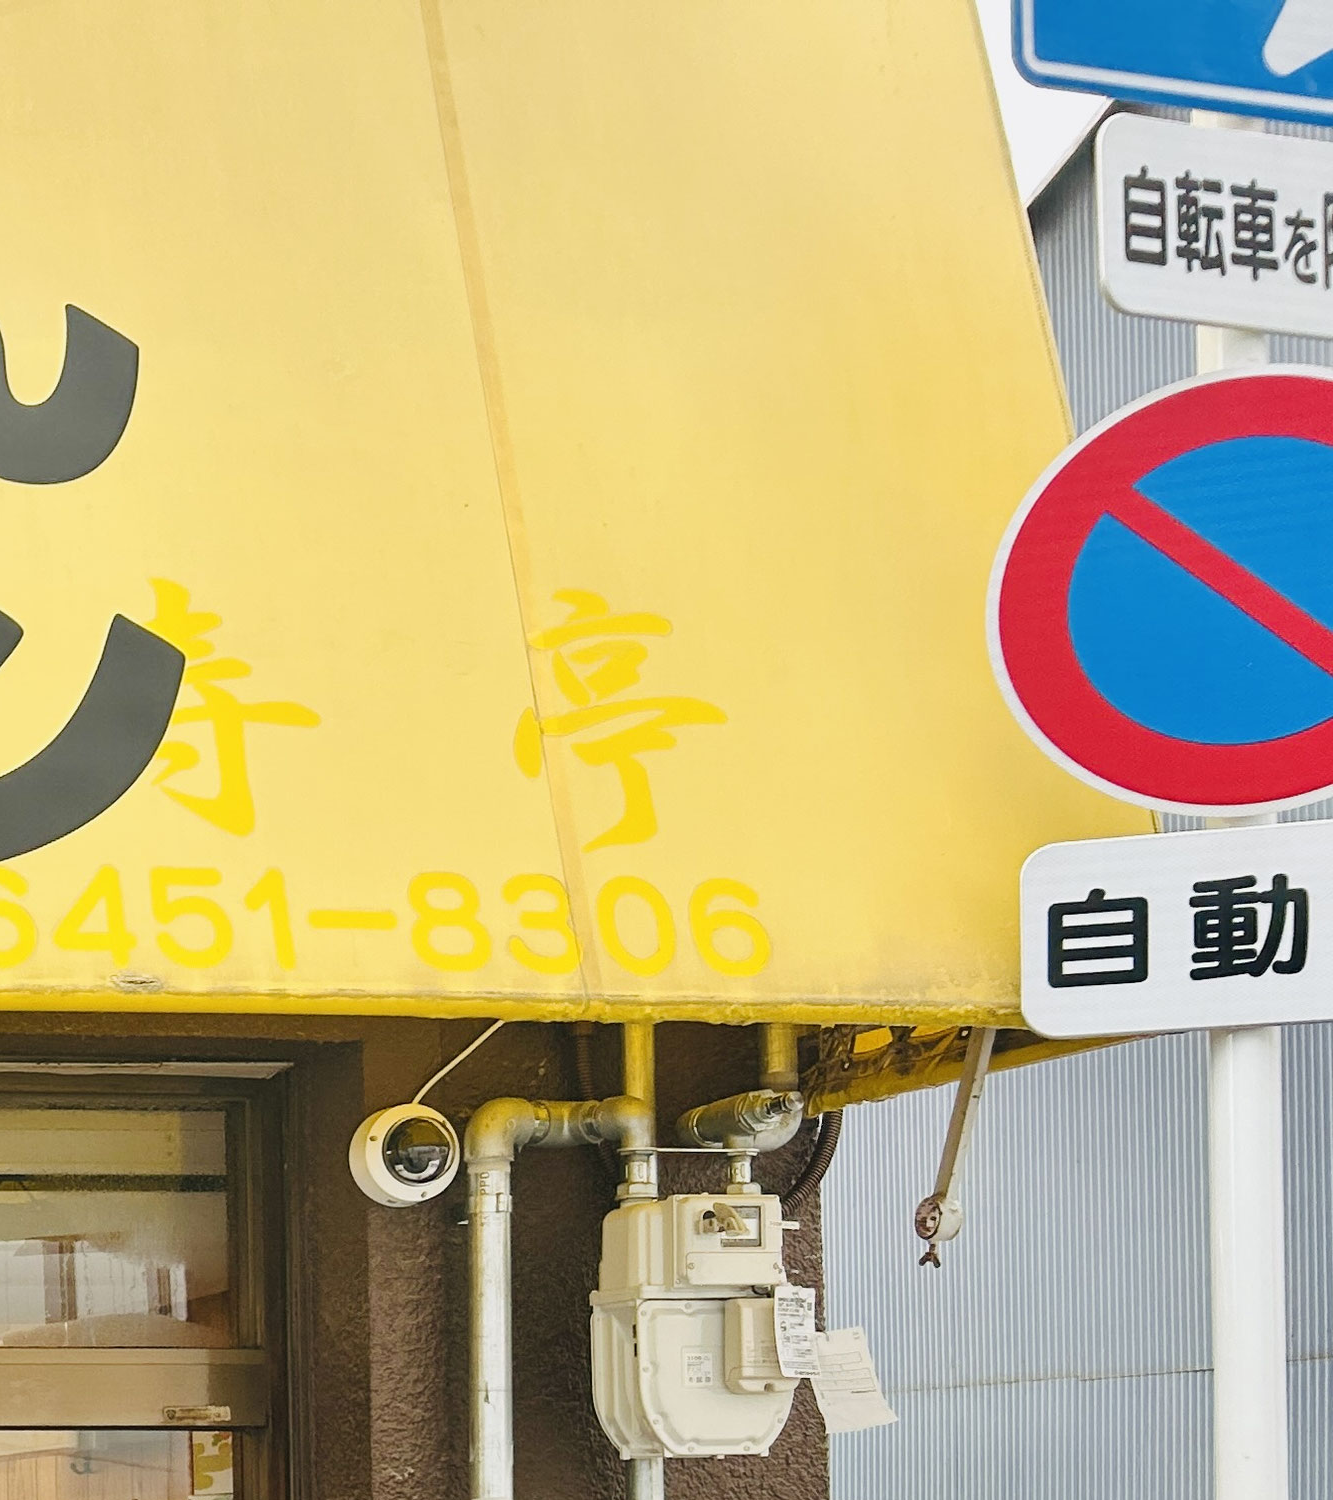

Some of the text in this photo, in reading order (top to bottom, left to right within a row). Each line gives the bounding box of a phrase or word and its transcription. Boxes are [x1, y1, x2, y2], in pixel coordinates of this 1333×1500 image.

[1123, 164, 1333, 290] 自転車を
[1047, 873, 1310, 989] 自動
